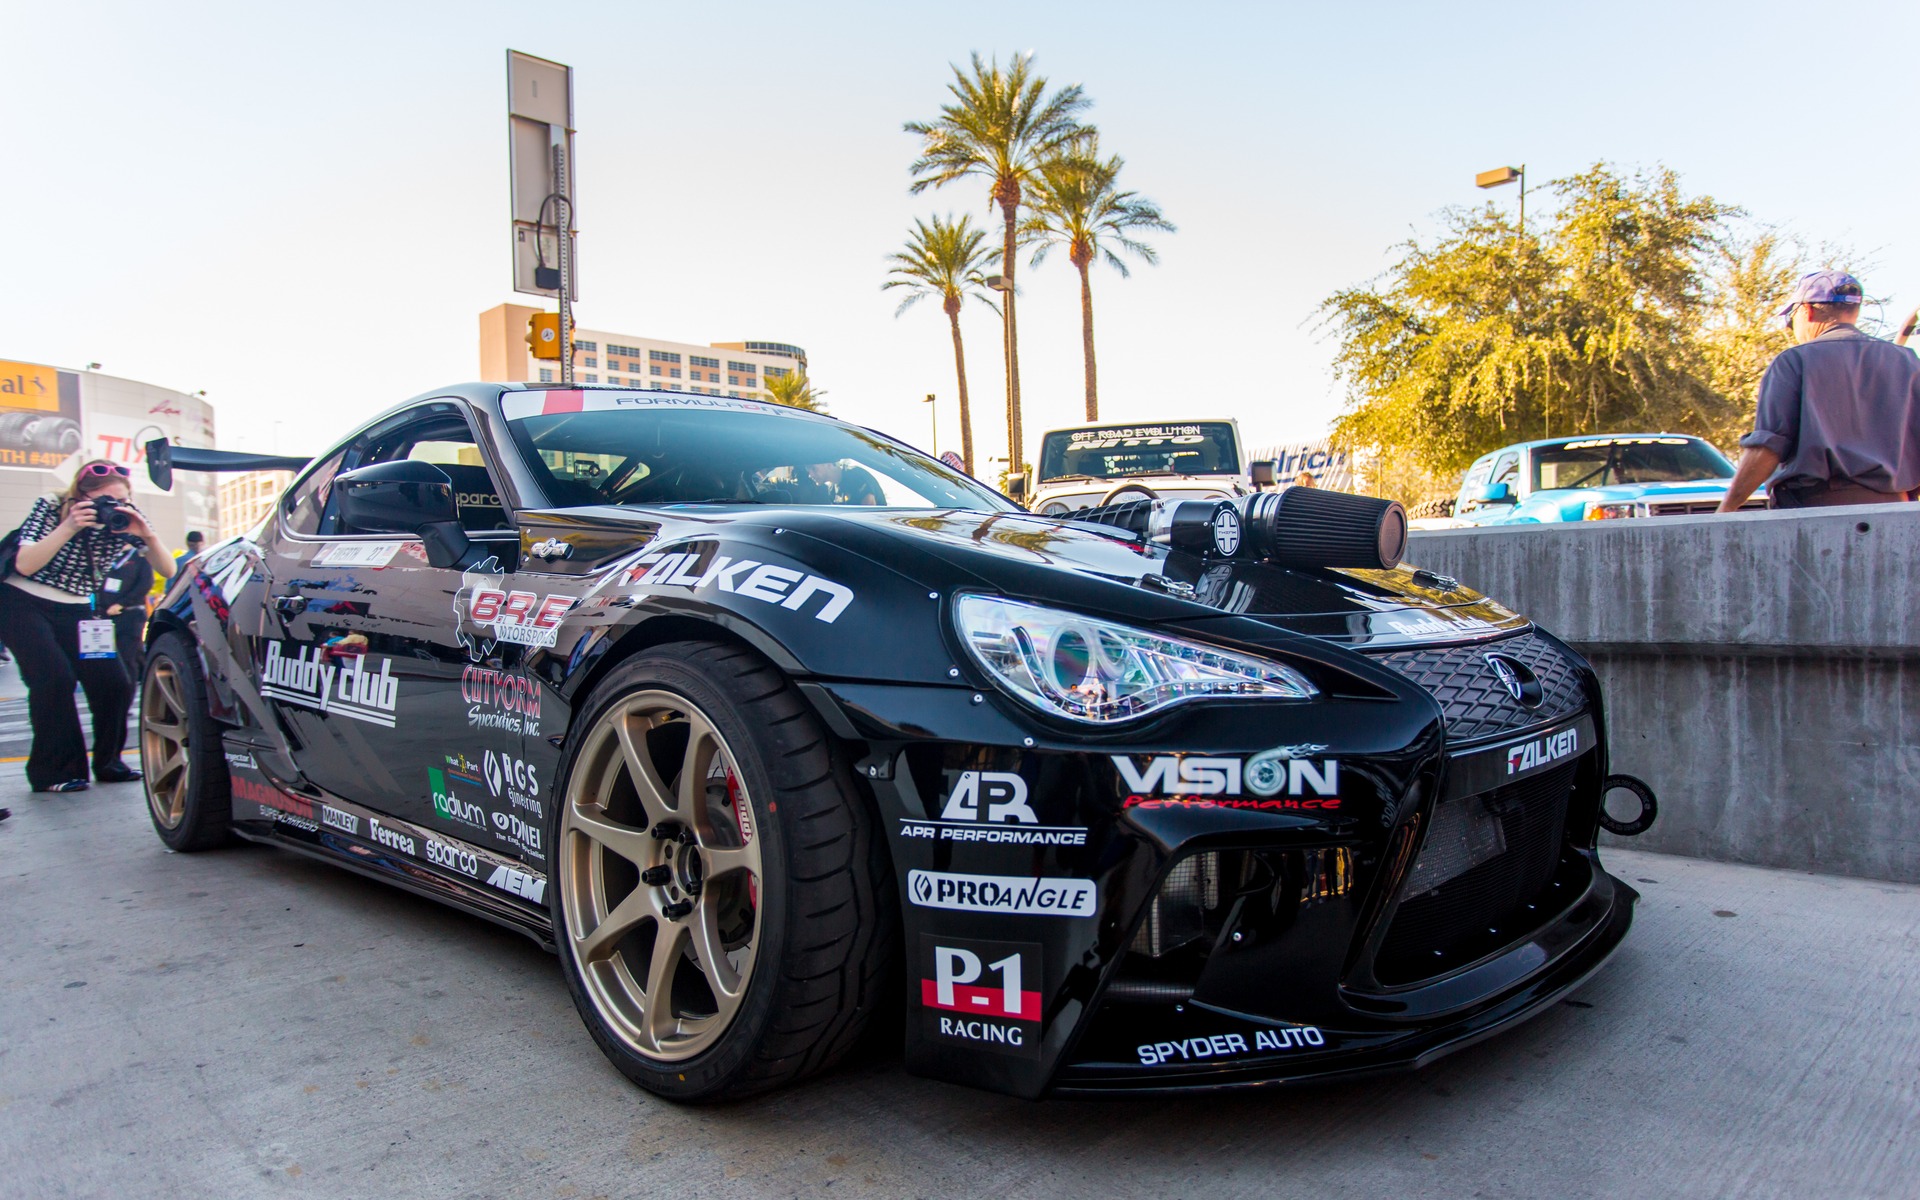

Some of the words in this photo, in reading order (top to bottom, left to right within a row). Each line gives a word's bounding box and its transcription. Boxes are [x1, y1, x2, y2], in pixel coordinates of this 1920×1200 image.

[1066, 436, 1204, 451] NITTO
[1072, 432, 1095, 442] OFF
[1098, 429, 1133, 440] ROAD
[1135, 425, 1200, 437] EVOLUTION
[1563, 438, 1688, 450] NITTO
[618, 553, 855, 624] FALKEN
[1508, 728, 1577, 775] FALKEN
[1111, 753, 1338, 797] VISION
[323, 806, 358, 834] MANLEY
[433, 790, 487, 827] radium
[1123, 795, 1342, 809] Performance
[370, 817, 415, 856] Ferrea
[901, 826, 935, 839] APR
[941, 828, 1087, 845] PERFORMANCE
[426, 839, 478, 877] sparco
[486, 865, 547, 904] AEM
[937, 877, 1088, 910] PROANGLE
[935, 946, 1022, 1014] P-1
[940, 1017, 1022, 1045] RACING
[1138, 1033, 1249, 1065] SPYDER
[1256, 1027, 1324, 1050] AUTO
